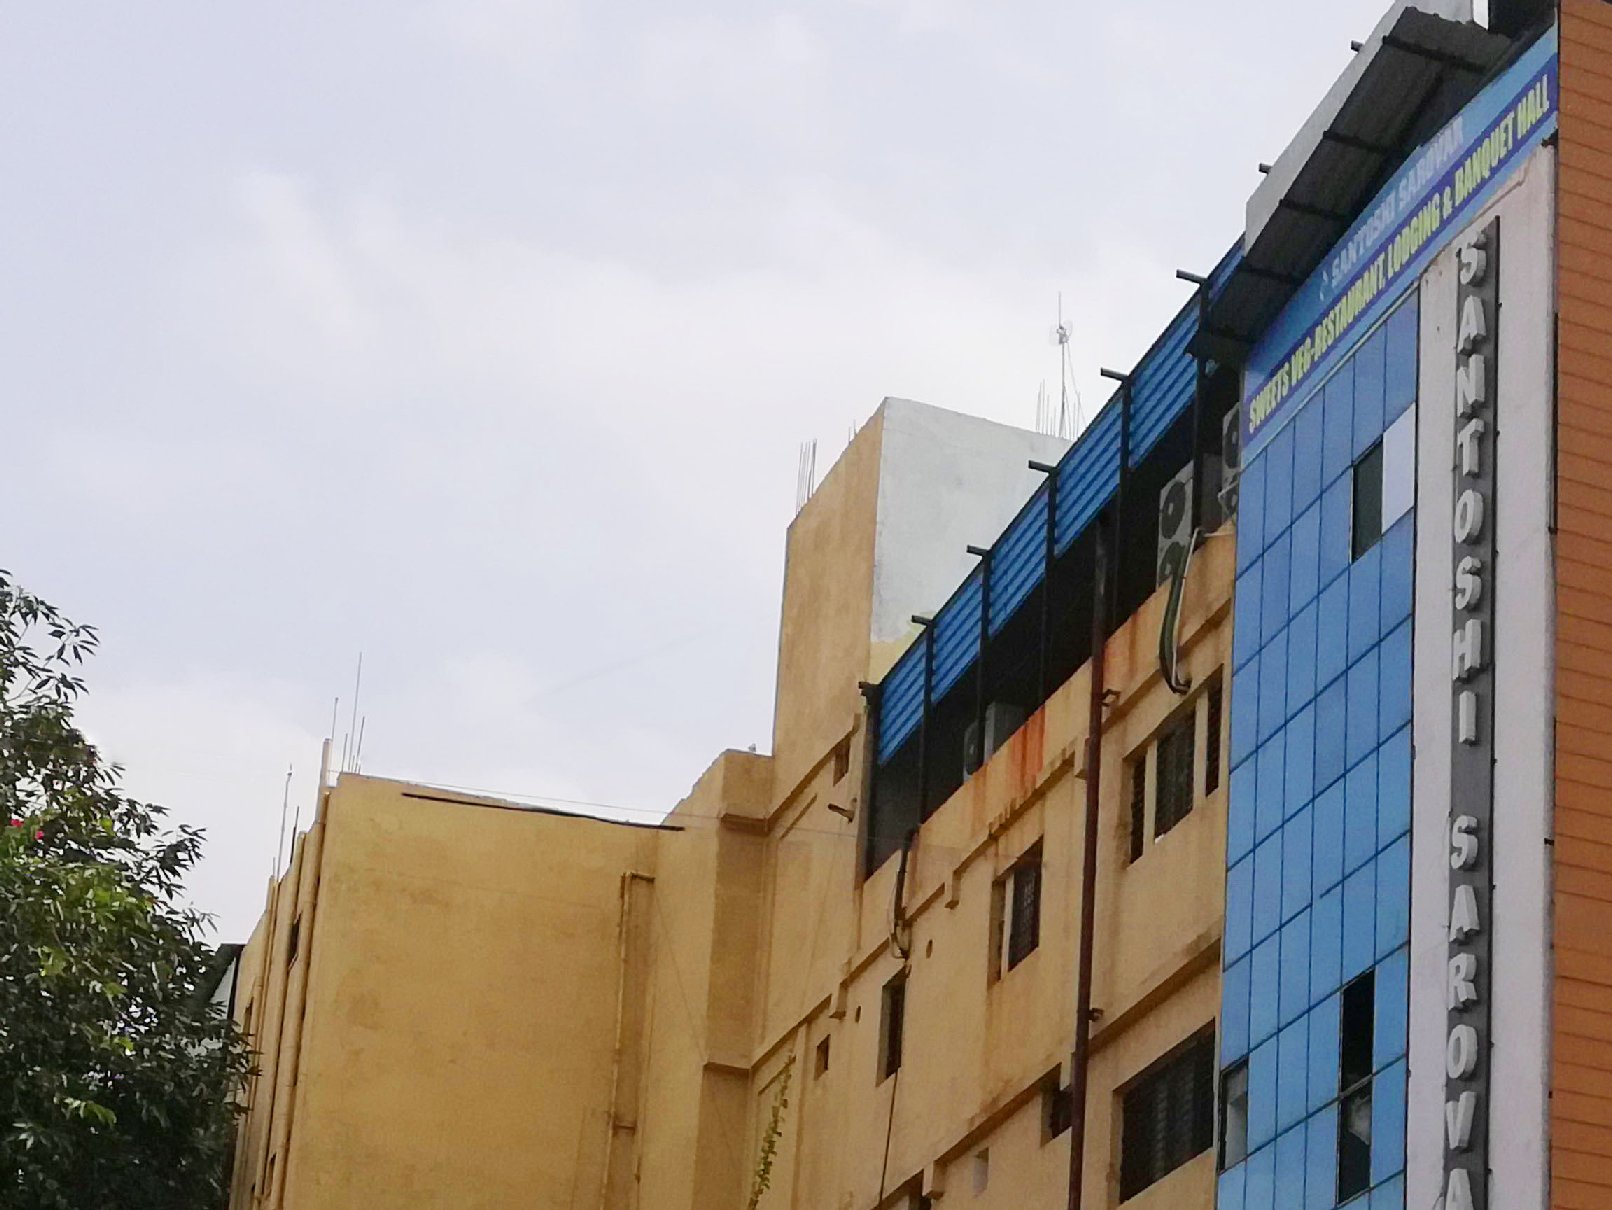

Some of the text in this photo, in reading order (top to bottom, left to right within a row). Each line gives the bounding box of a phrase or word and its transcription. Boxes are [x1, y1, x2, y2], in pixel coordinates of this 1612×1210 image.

[1249, 361, 1289, 434] SWEETS
[1387, 192, 1440, 281] LODGING
[1443, 186, 1453, 220] &
[1454, 112, 1514, 207] BANQUET
[1517, 74, 1550, 137] HALL
[1452, 228, 1487, 746] SANTOSHI
